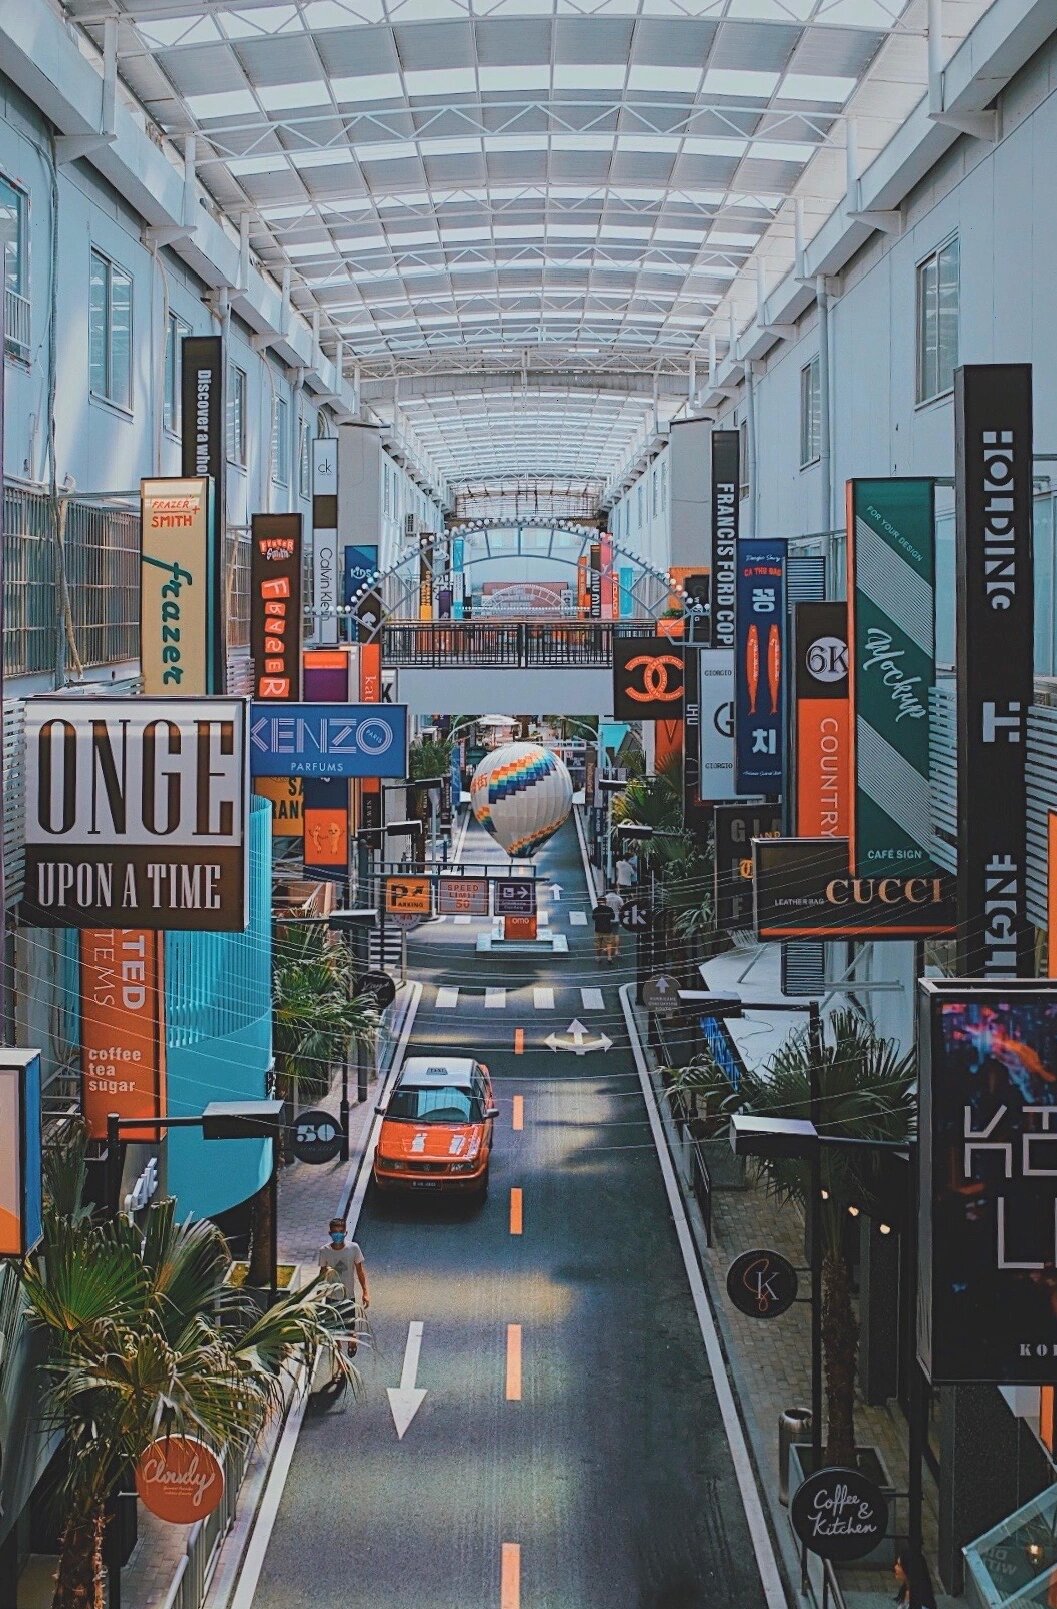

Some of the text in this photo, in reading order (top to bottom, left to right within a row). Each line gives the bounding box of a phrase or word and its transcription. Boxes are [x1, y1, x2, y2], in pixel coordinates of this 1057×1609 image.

[197, 369, 212, 433] Discover
[197, 433, 209, 443] a
[318, 458, 333, 474] ck
[151, 501, 191, 509] FRAZER
[151, 515, 193, 528] SMITH
[866, 505, 924, 562] FOR YOUR DESIGN
[716, 483, 735, 649] FRANCIS FORD COP
[319, 547, 333, 622] Calvin Klein
[142, 555, 193, 685] frazer
[807, 645, 849, 674] 6K
[863, 627, 927, 723] Mockup
[250, 717, 394, 756] KENZO
[365, 729, 383, 744] PARIS
[290, 762, 344, 772] PARFUMS
[819, 717, 839, 838] COUNTRY
[868, 848, 922, 860] CAFÉ SIGN
[36, 862, 221, 910] UPON A TIME
[447, 884, 479, 892] SPEED
[455, 899, 470, 909] 50
[774, 898, 825, 907] LEATHER BAG
[511, 917, 530, 925] omo
[122, 929, 146, 1010] TED
[88, 1047, 142, 1061] coffee
[88, 1063, 116, 1077] tea
[88, 1080, 136, 1094] sugar
[297, 1123, 336, 1142] 50
[143, 1455, 216, 1507] Cloudy
[813, 1484, 861, 1516] Coffee
[857, 1502, 874, 1519] &
[808, 1510, 878, 1537] Kitchen
